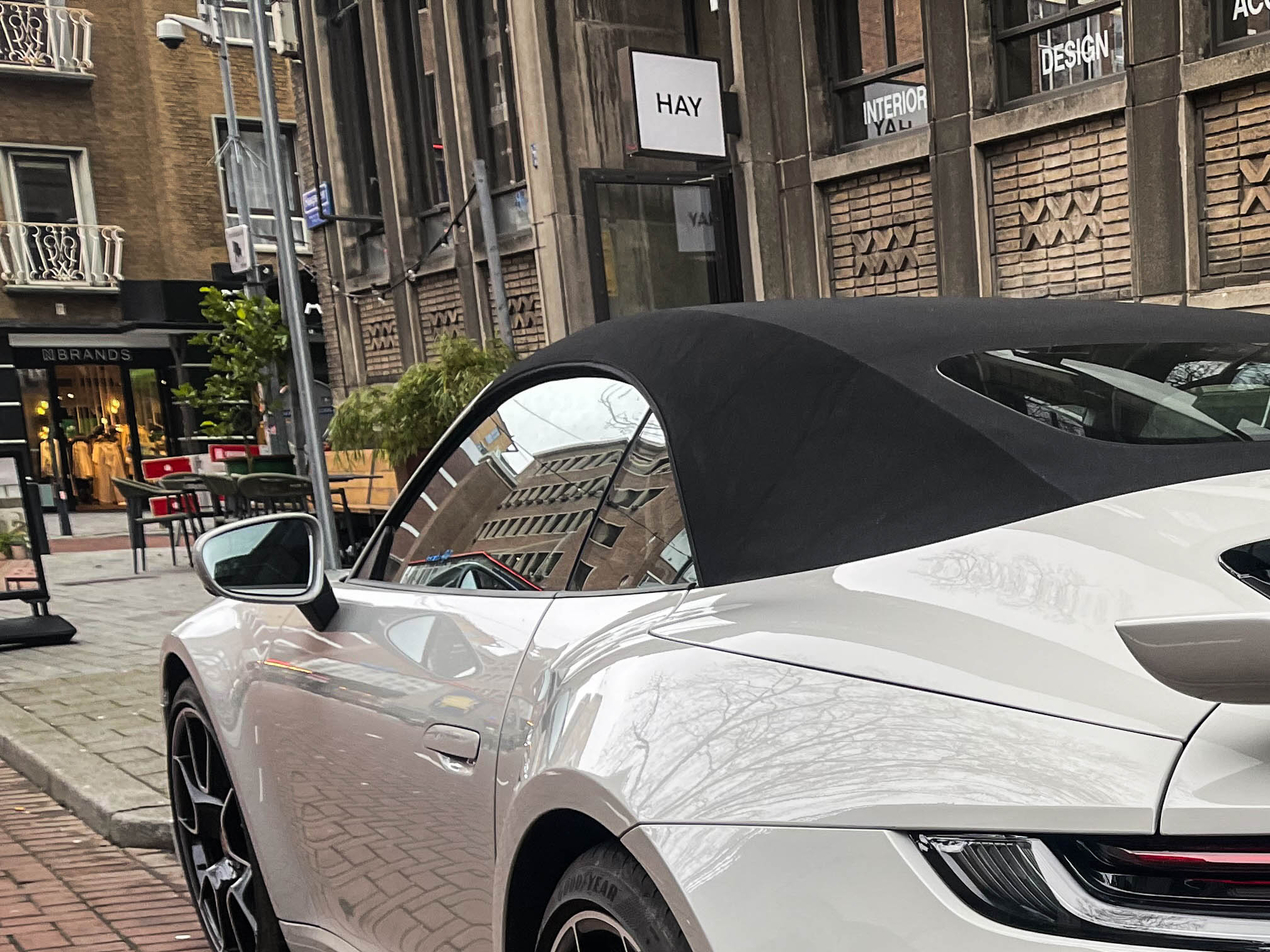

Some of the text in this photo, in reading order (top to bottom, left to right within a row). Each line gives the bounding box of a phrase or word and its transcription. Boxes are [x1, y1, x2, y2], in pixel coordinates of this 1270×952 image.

[1041, 29, 1109, 76] DESIGN
[656, 93, 702, 117] HAY
[863, 86, 927, 125] INTERIOR
